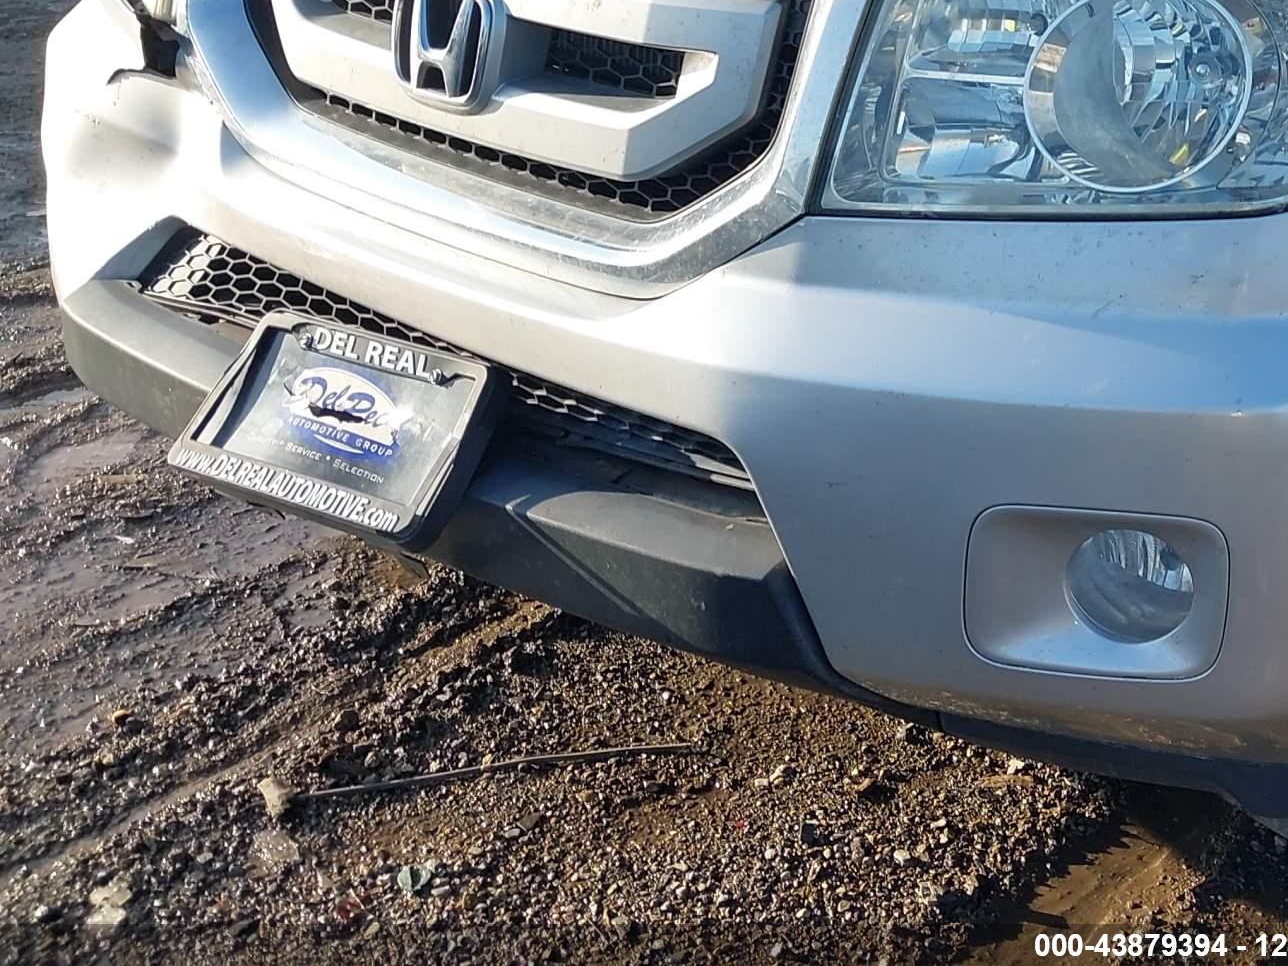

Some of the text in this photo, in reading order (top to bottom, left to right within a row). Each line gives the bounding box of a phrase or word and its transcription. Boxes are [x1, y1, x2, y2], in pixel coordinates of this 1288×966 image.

[314, 327, 432, 378] DEL REAL
[287, 416, 350, 443] AUTOMOTIVE
[354, 437, 393, 457] GROUP
[285, 442, 385, 484] SERVICE SELECTION
[175, 447, 400, 532] www.DELREALAUTOMOTIVE.com
